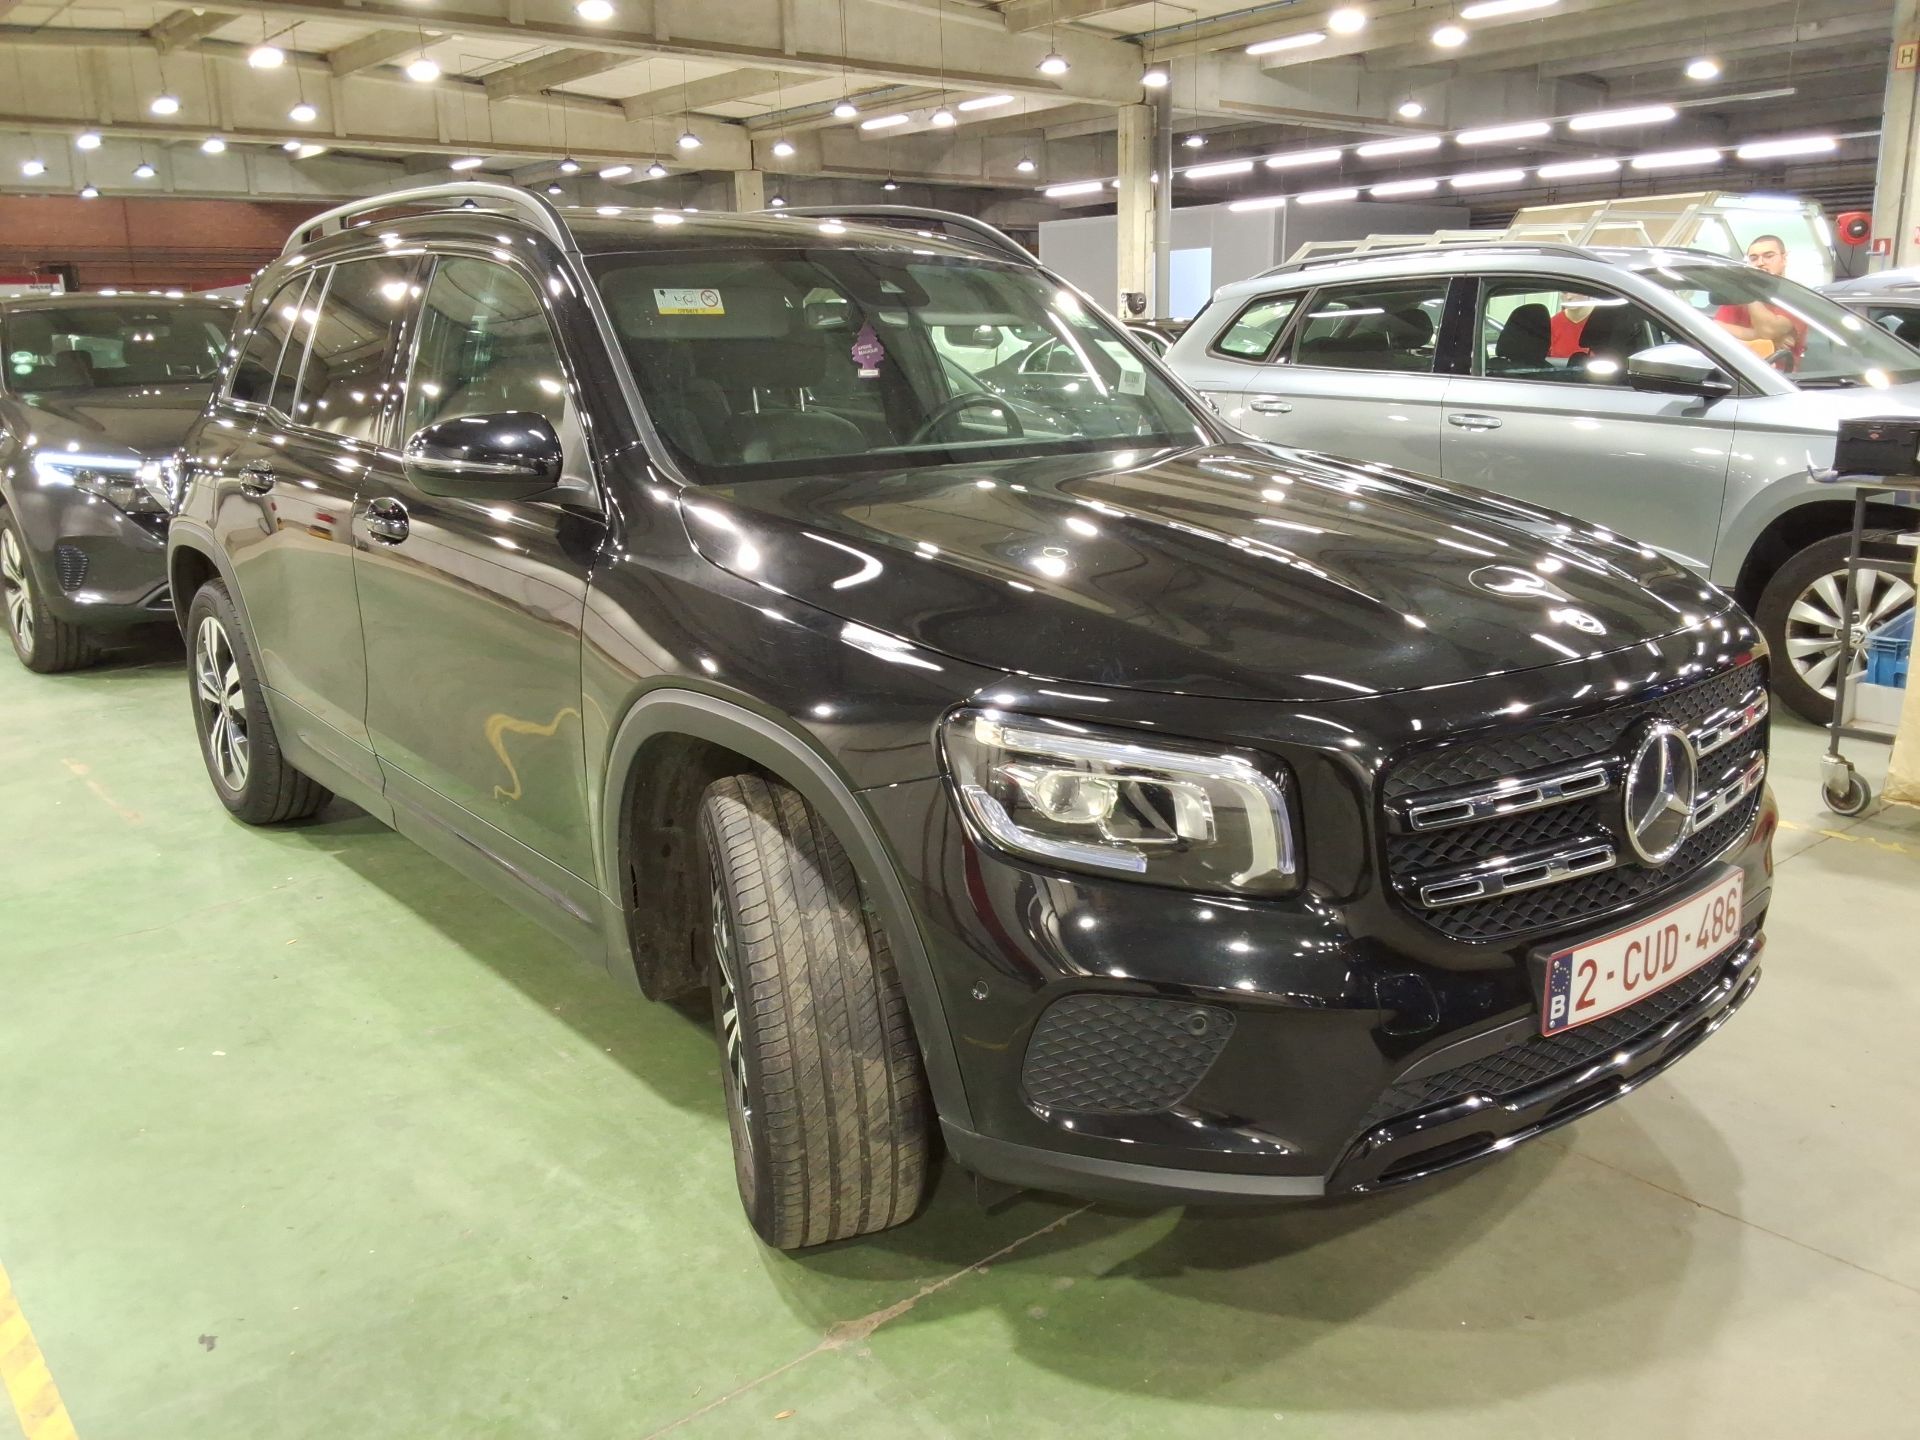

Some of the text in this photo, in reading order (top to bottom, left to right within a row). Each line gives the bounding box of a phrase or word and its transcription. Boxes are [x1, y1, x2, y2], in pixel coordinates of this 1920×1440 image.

[1901, 49, 1914, 63] H
[1575, 887, 1737, 1011] 2-CUD-486
[1550, 994, 1566, 1020] B
